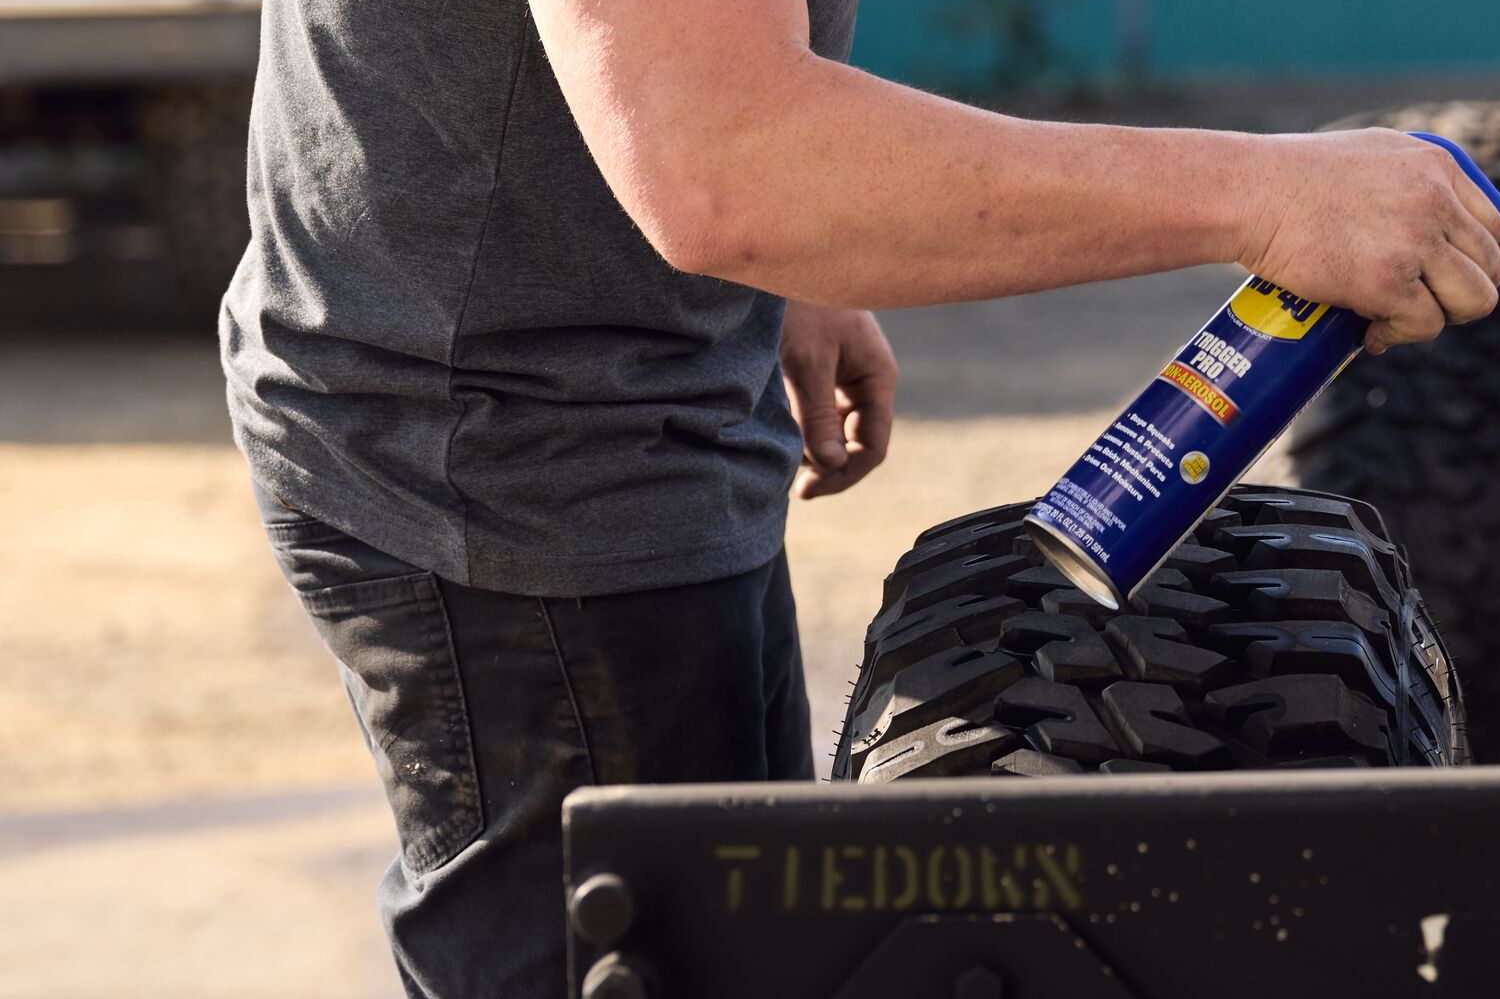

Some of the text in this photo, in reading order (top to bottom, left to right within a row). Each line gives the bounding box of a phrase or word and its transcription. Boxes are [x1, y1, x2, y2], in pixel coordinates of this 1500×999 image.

[1194, 330, 1252, 378] TRIGGER
[1243, 325, 1271, 341] PRODUCT
[1114, 422, 1138, 438] Removes
[1136, 435, 1145, 443] &
[1143, 439, 1174, 469] Protects
[1130, 413, 1175, 450] Stops Squeaks
[1084, 454, 1144, 501] Drives Out Moisture
[1101, 447, 1121, 463] Sticky
[1119, 459, 1161, 498] Mechanisms
[1103, 433, 1123, 447] Loosens
[1122, 443, 1147, 464] Rusted
[1145, 461, 1166, 482] Parts
[1050, 509, 1060, 518] 20
[1056, 512, 1065, 522] FL
[1062, 517, 1073, 528] OZ
[1069, 523, 1086, 539] (1.25
[1082, 534, 1094, 547] PT)
[715, 845, 1082, 909] TIEDOWN
